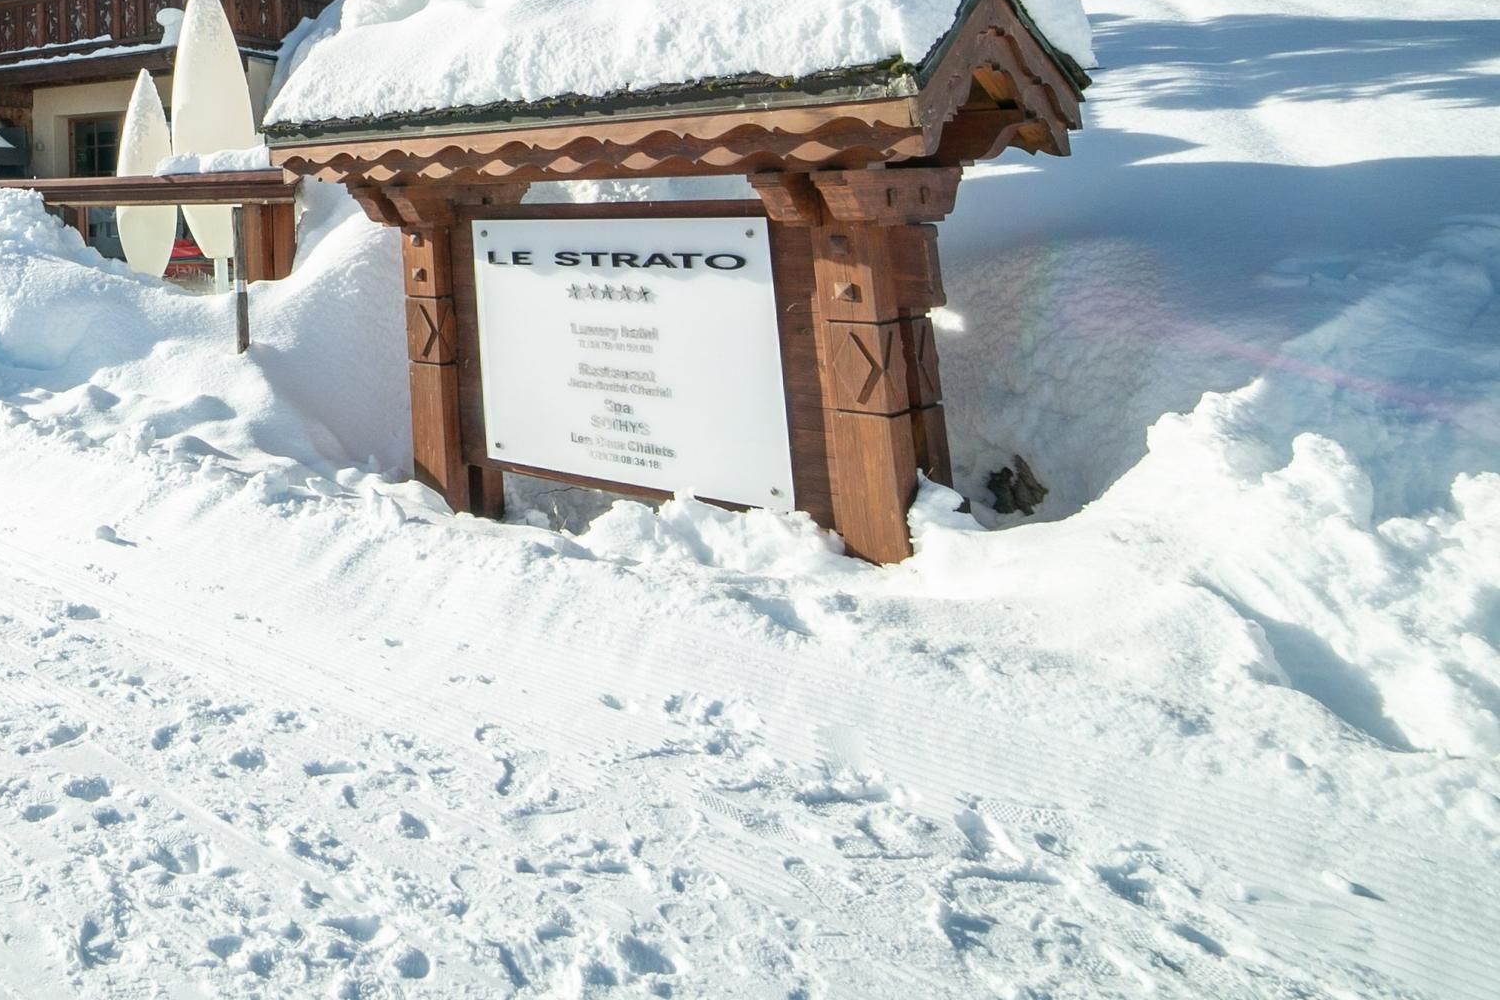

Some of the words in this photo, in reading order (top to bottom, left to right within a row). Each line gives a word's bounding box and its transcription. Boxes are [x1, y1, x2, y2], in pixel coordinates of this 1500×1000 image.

[487, 250, 533, 266] LE
[554, 251, 748, 271] STRATO
[603, 398, 634, 415] Spa
